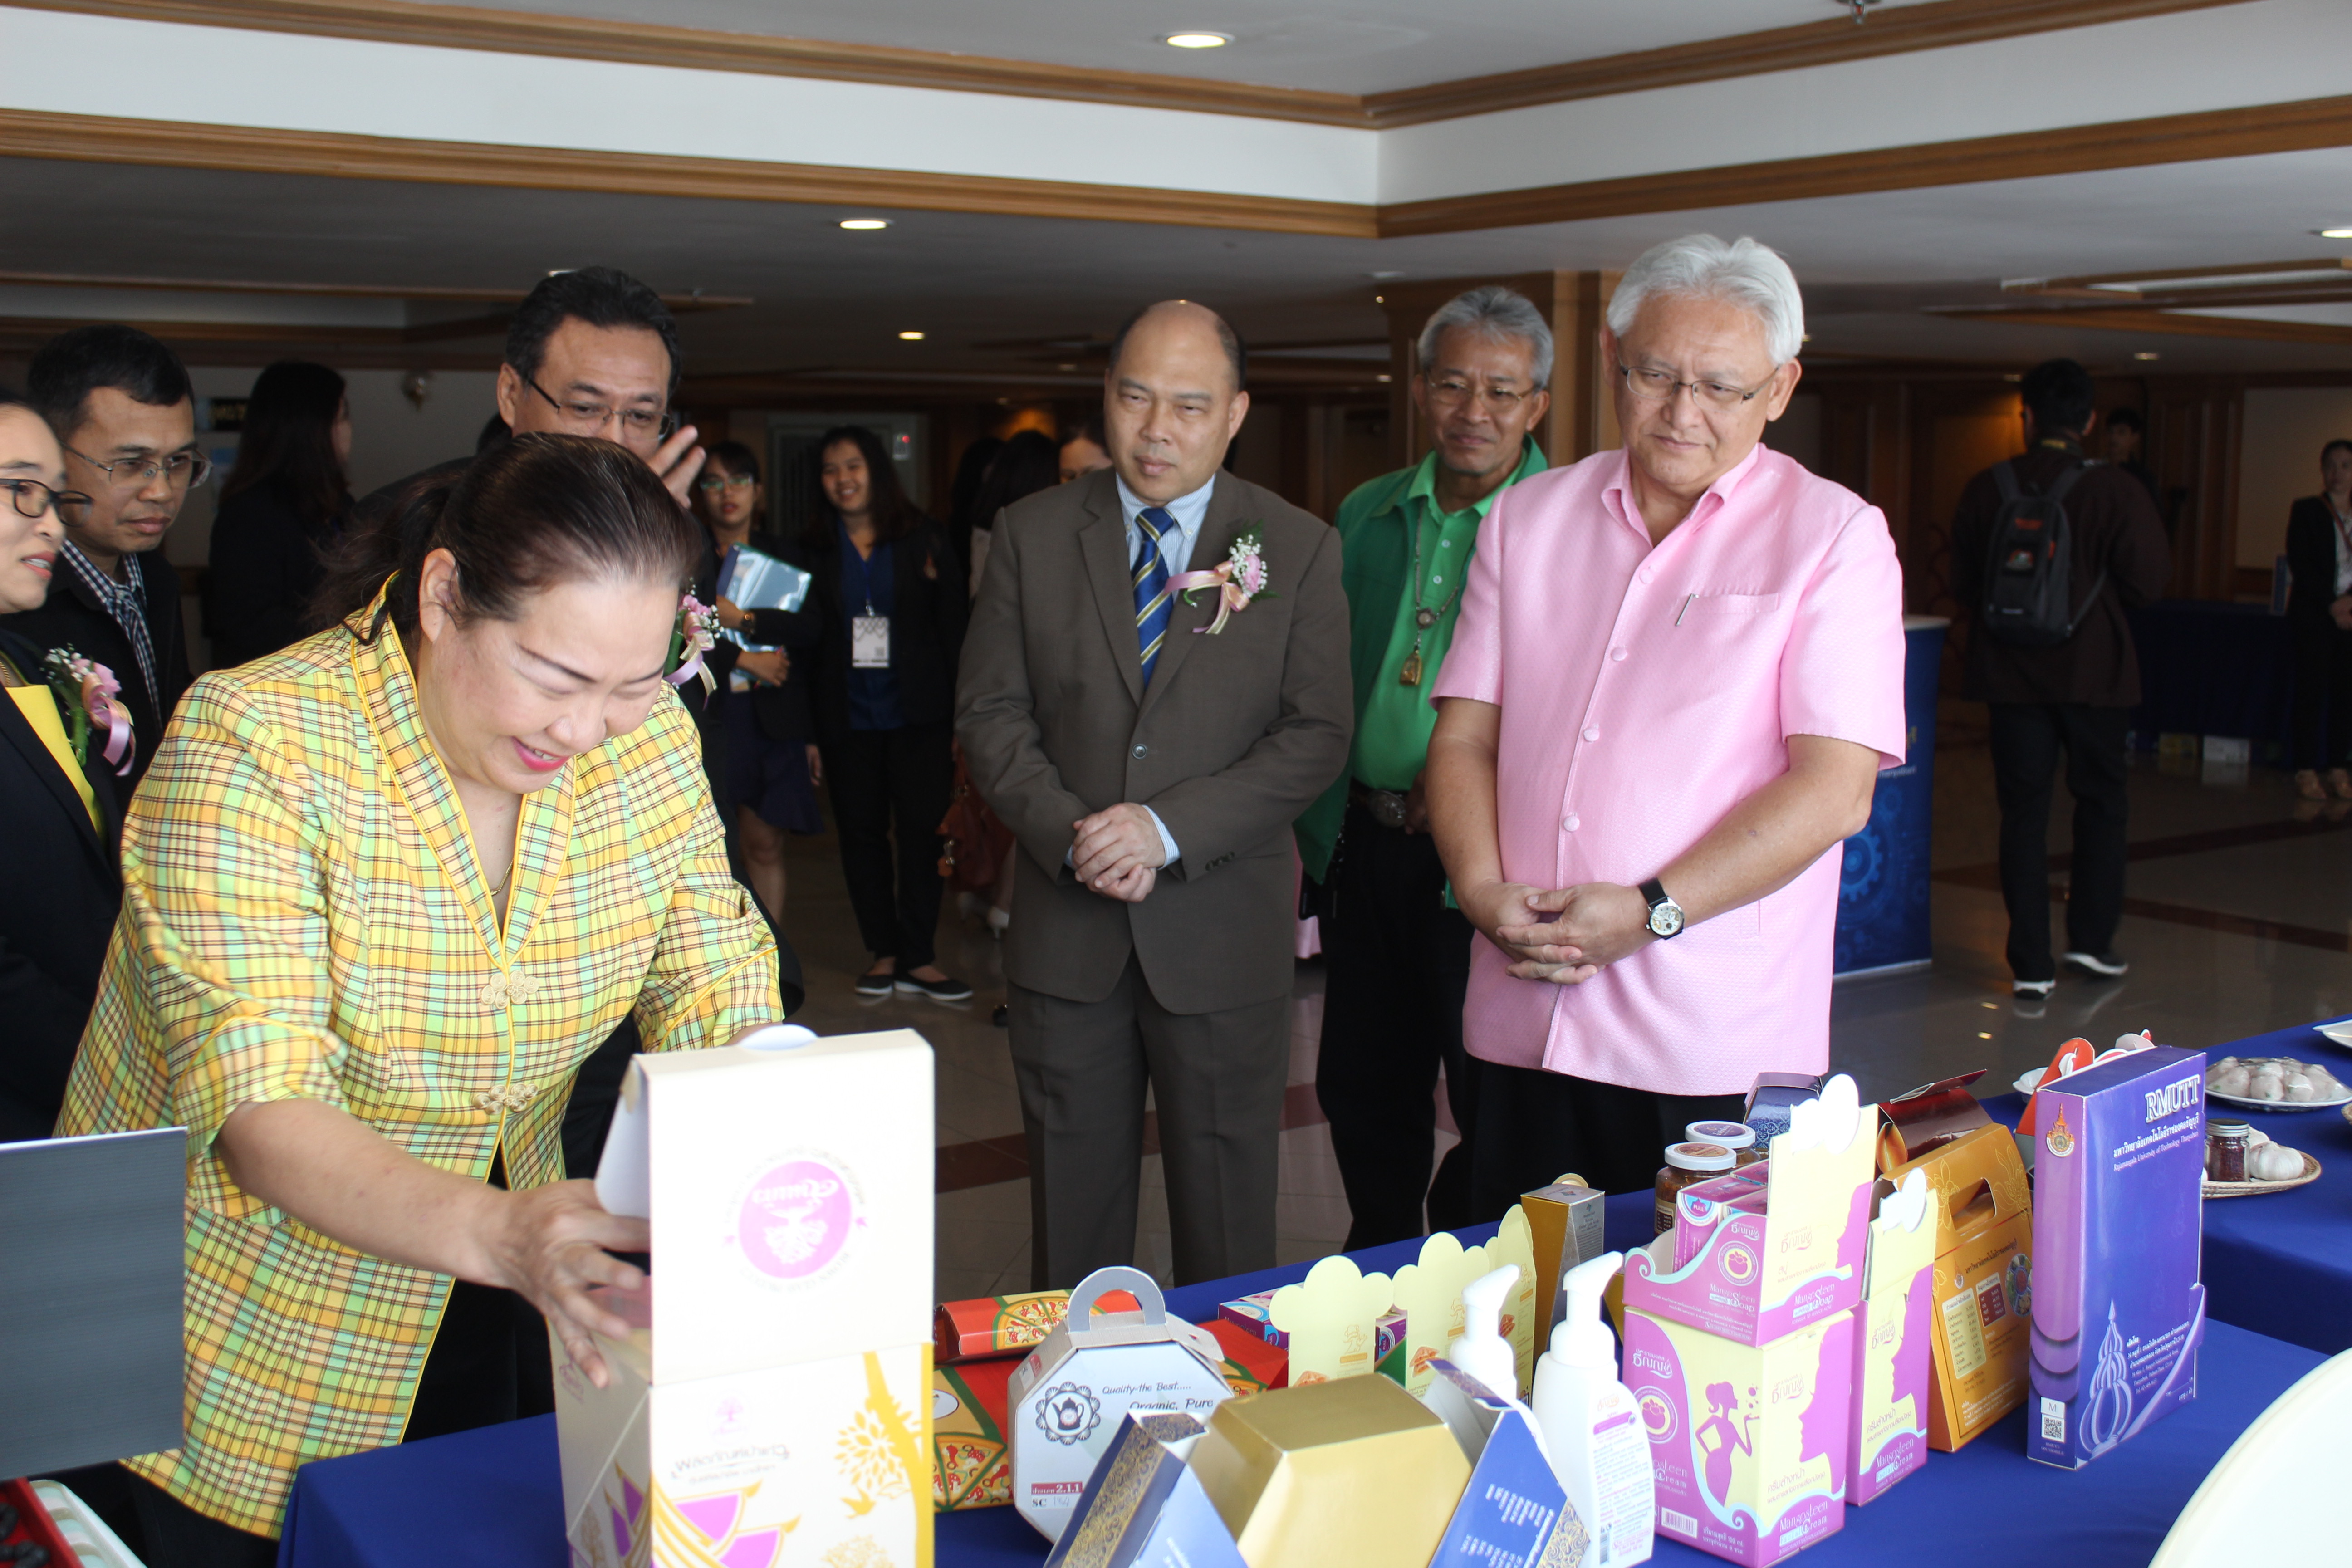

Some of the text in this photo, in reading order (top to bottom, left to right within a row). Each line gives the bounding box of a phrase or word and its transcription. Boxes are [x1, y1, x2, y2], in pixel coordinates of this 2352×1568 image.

[2145, 1074, 2200, 1123] RMUTT
[2137, 1148, 2155, 1161] University
[2156, 1145, 2161, 1153] of
[2161, 1138, 2180, 1152] Technology
[1730, 1292, 1755, 1313] Soap
[1811, 1290, 1834, 1310] Soap
[1185, 1398, 1214, 1409] Pure
[2048, 1402, 2057, 1412] M
[1867, 1407, 1896, 1434] ครีมล้างหน้า
[1876, 1437, 1914, 1470] Mangosteen
[1891, 1452, 1913, 1471] Cream
[1653, 1457, 1687, 1478] osteen
[1767, 1468, 1805, 1494] ครีมล้างหน้า
[1779, 1500, 1828, 1533] Mangosteen
[1801, 1515, 1828, 1535] Cream
[1727, 1534, 1736, 1544] 100
